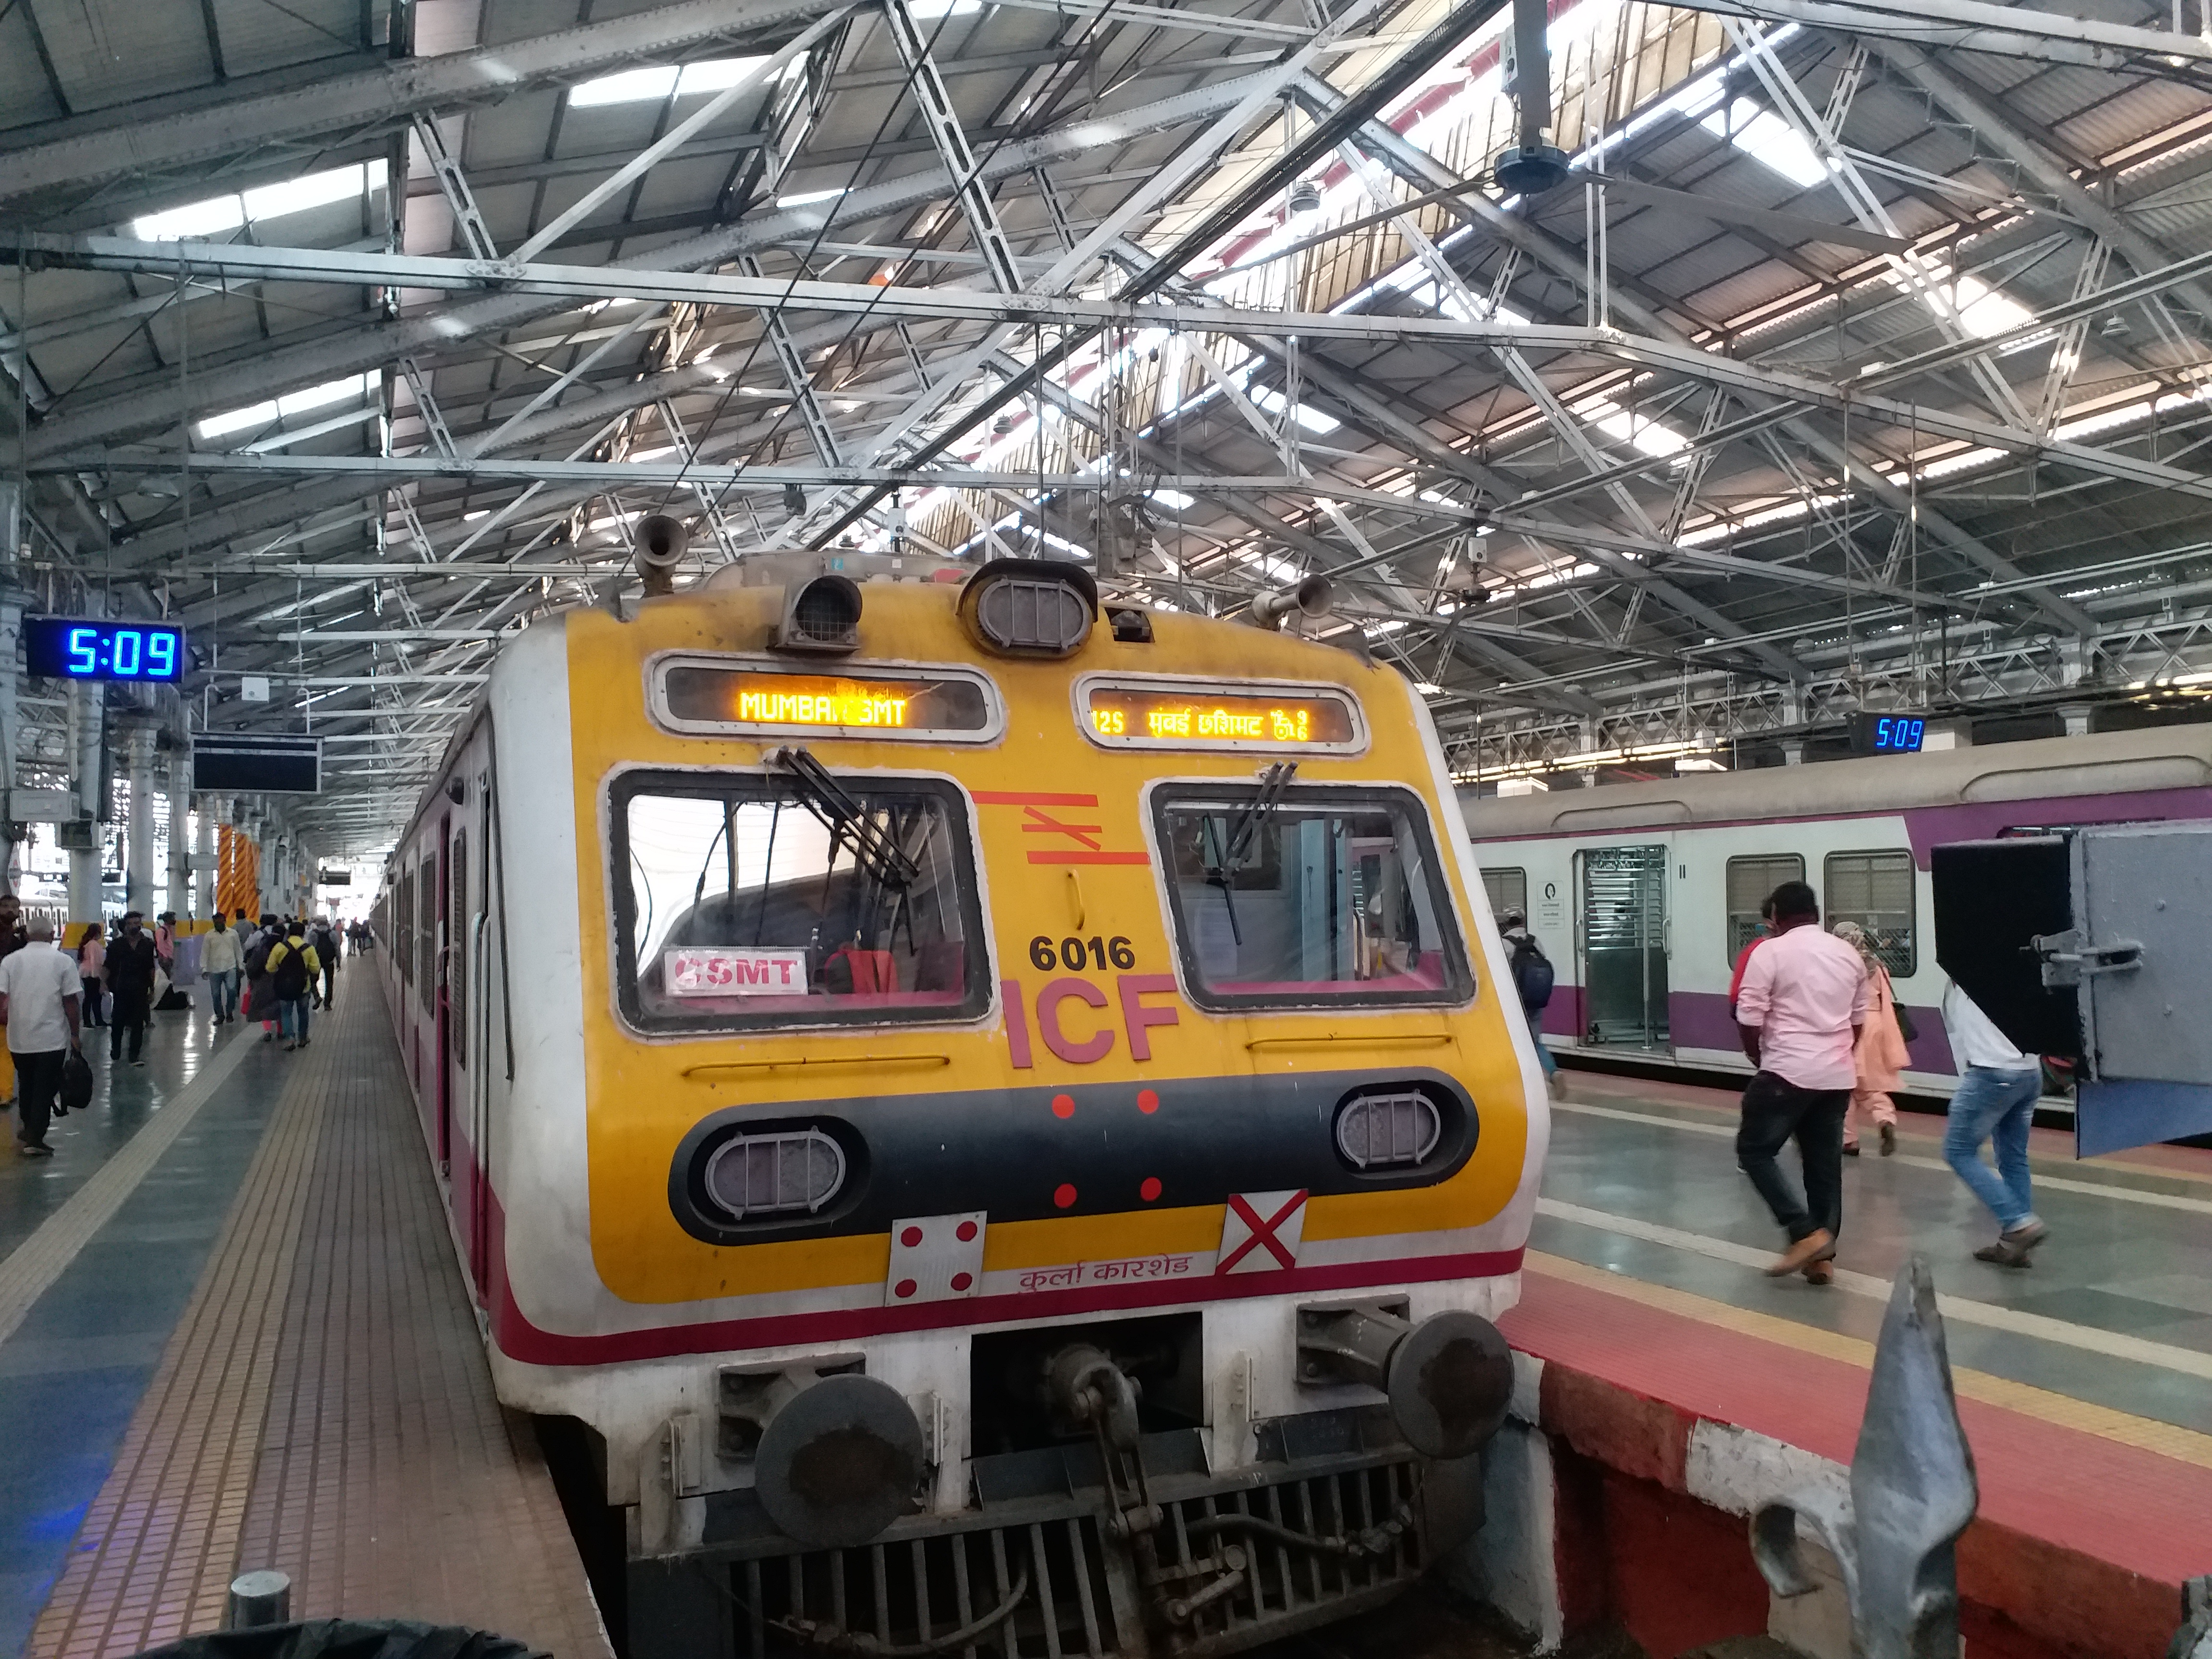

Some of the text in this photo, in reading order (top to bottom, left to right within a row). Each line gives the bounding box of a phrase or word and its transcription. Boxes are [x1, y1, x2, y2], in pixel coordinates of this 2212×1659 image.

[69, 628, 175, 675] 5:09
[1876, 719, 1923, 748] 5:09
[1030, 936, 1135, 971] 6016
[1000, 974, 1178, 1068] ICF
[1094, 1253, 1193, 1279] कारशेड
